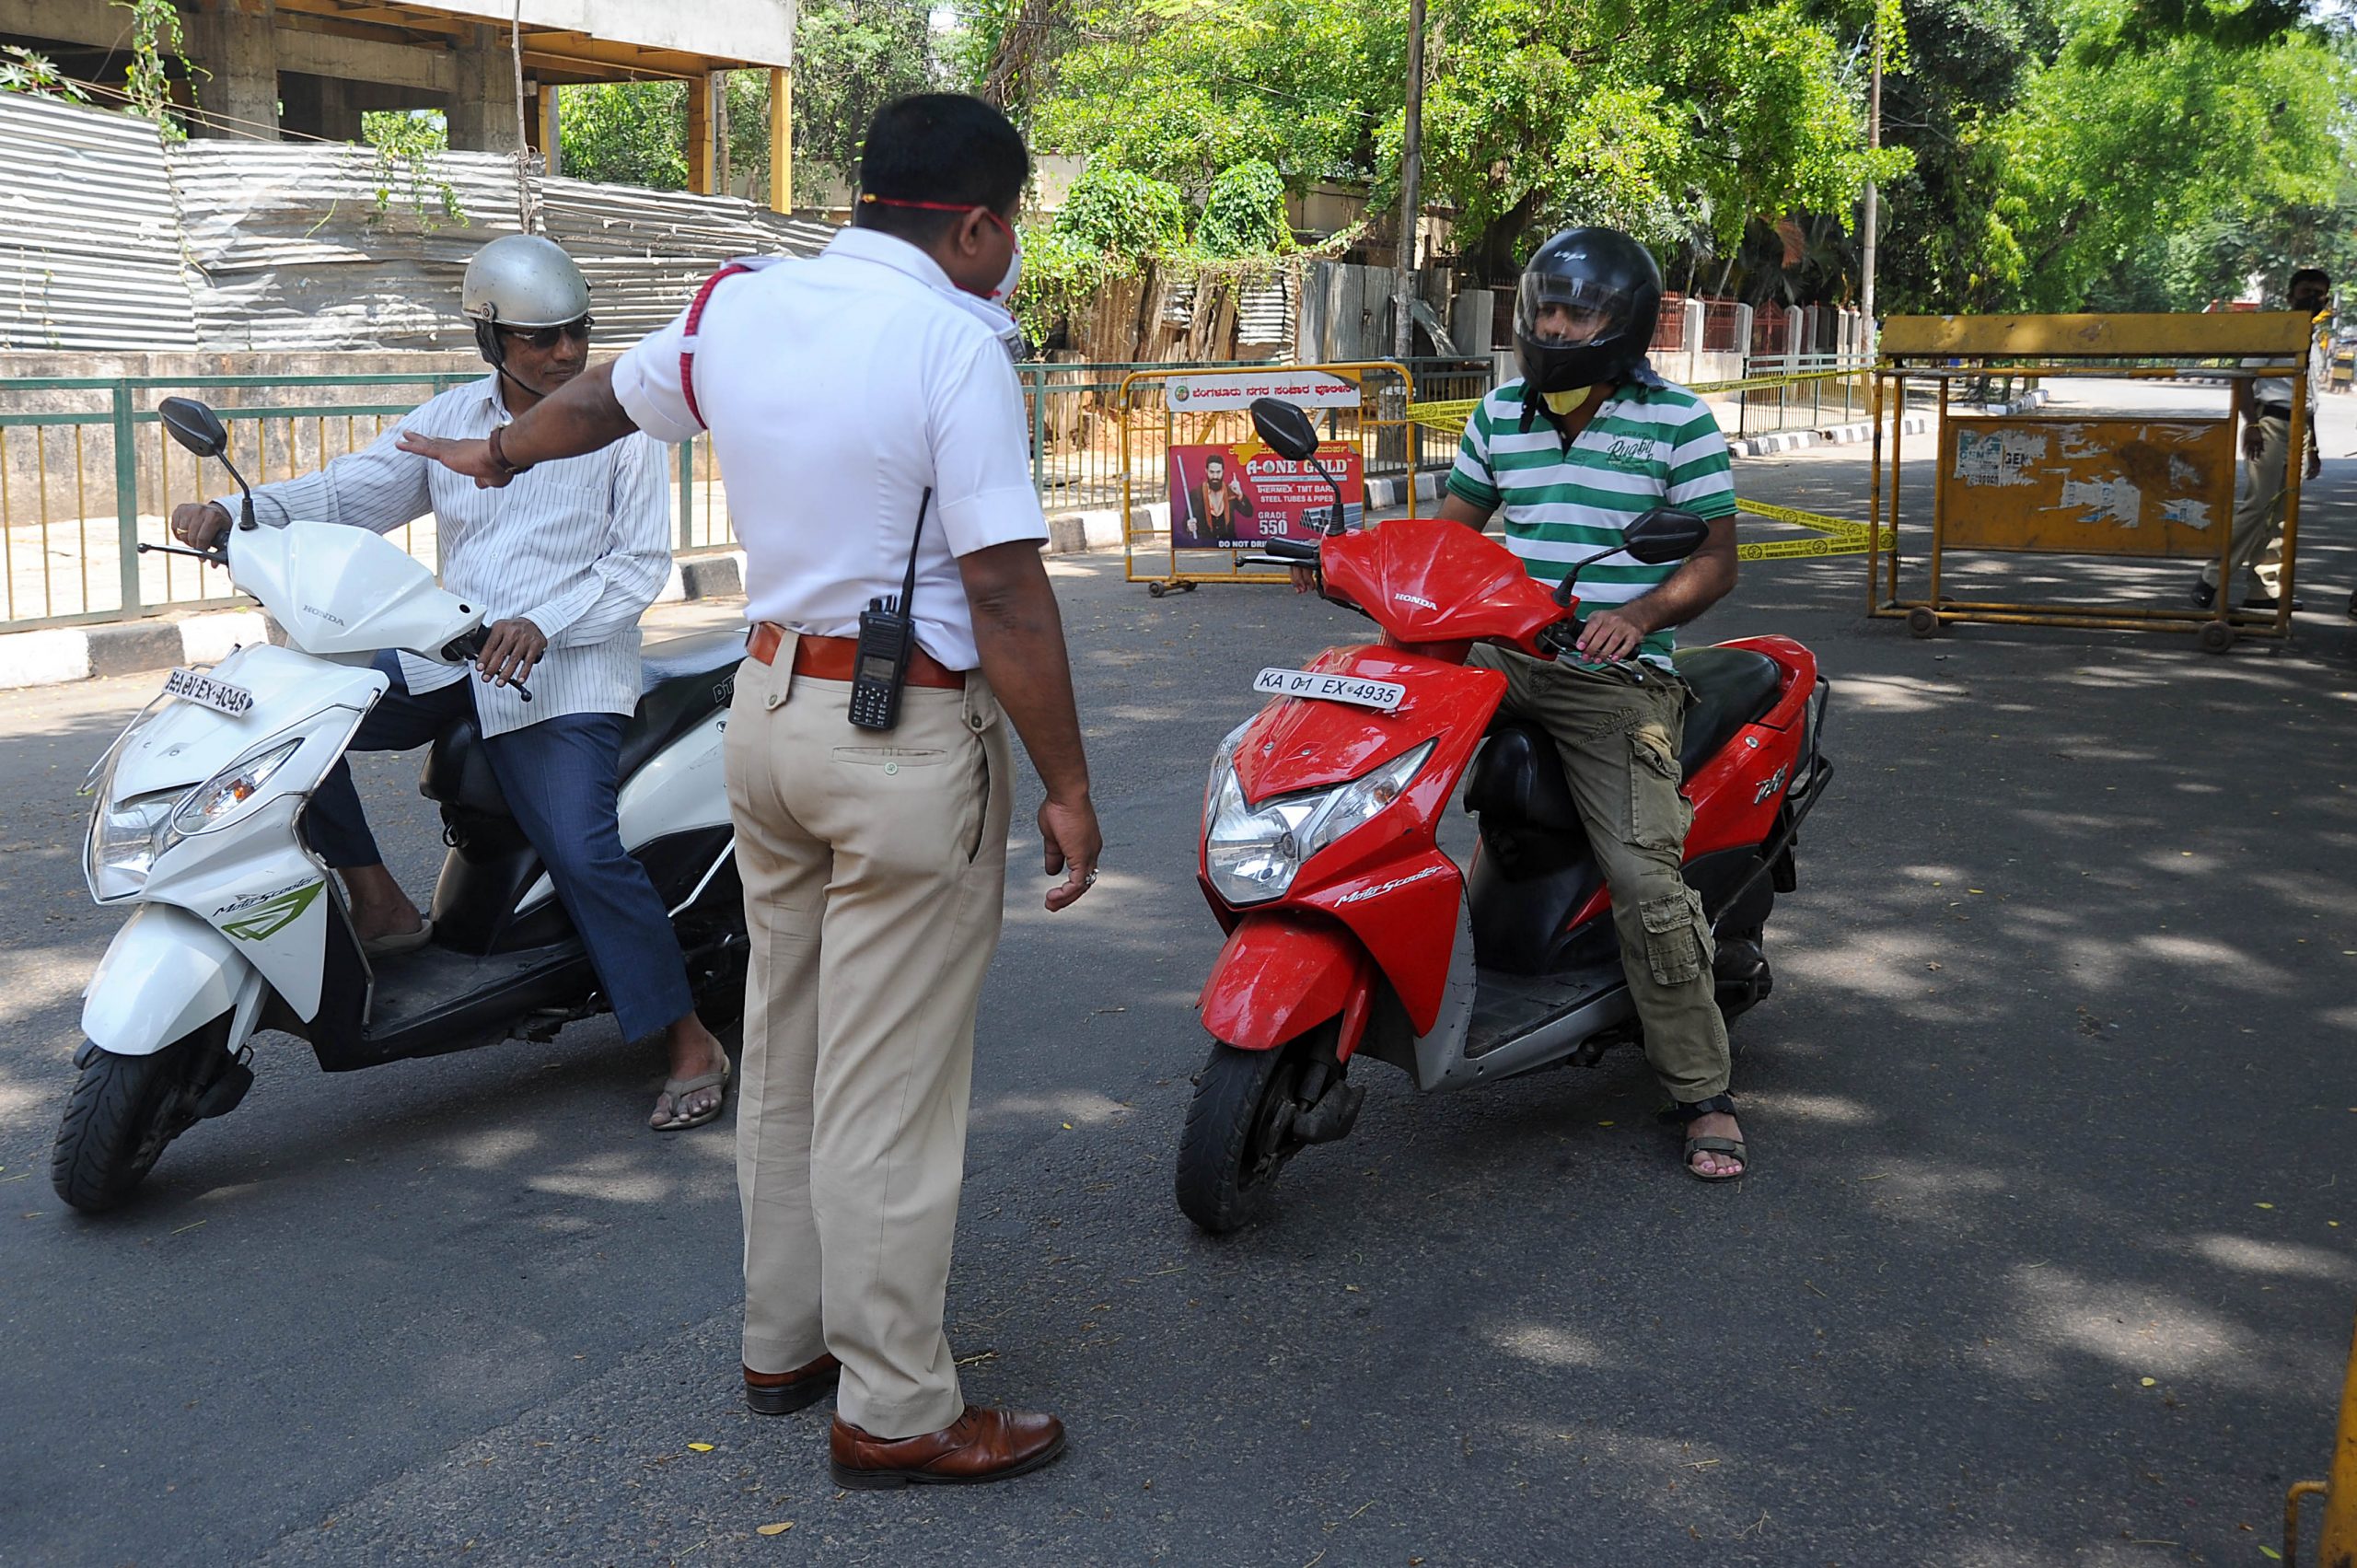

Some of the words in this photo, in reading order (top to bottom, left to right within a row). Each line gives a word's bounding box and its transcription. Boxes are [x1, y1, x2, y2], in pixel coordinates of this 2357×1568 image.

[1247, 386, 1270, 396] ನಗರ
[1606, 437, 1655, 463] Rugby
[1246, 459, 1297, 475] A-ONE
[1258, 511, 1287, 519] GRADE
[1259, 520, 1288, 535] 550
[1394, 593, 1438, 610] HONDA
[302, 604, 345, 627] HONDA
[1260, 673, 1283, 689] KA
[1290, 677, 1313, 691] 01
[1321, 679, 1347, 695] EX
[1353, 684, 1397, 703] 4935
